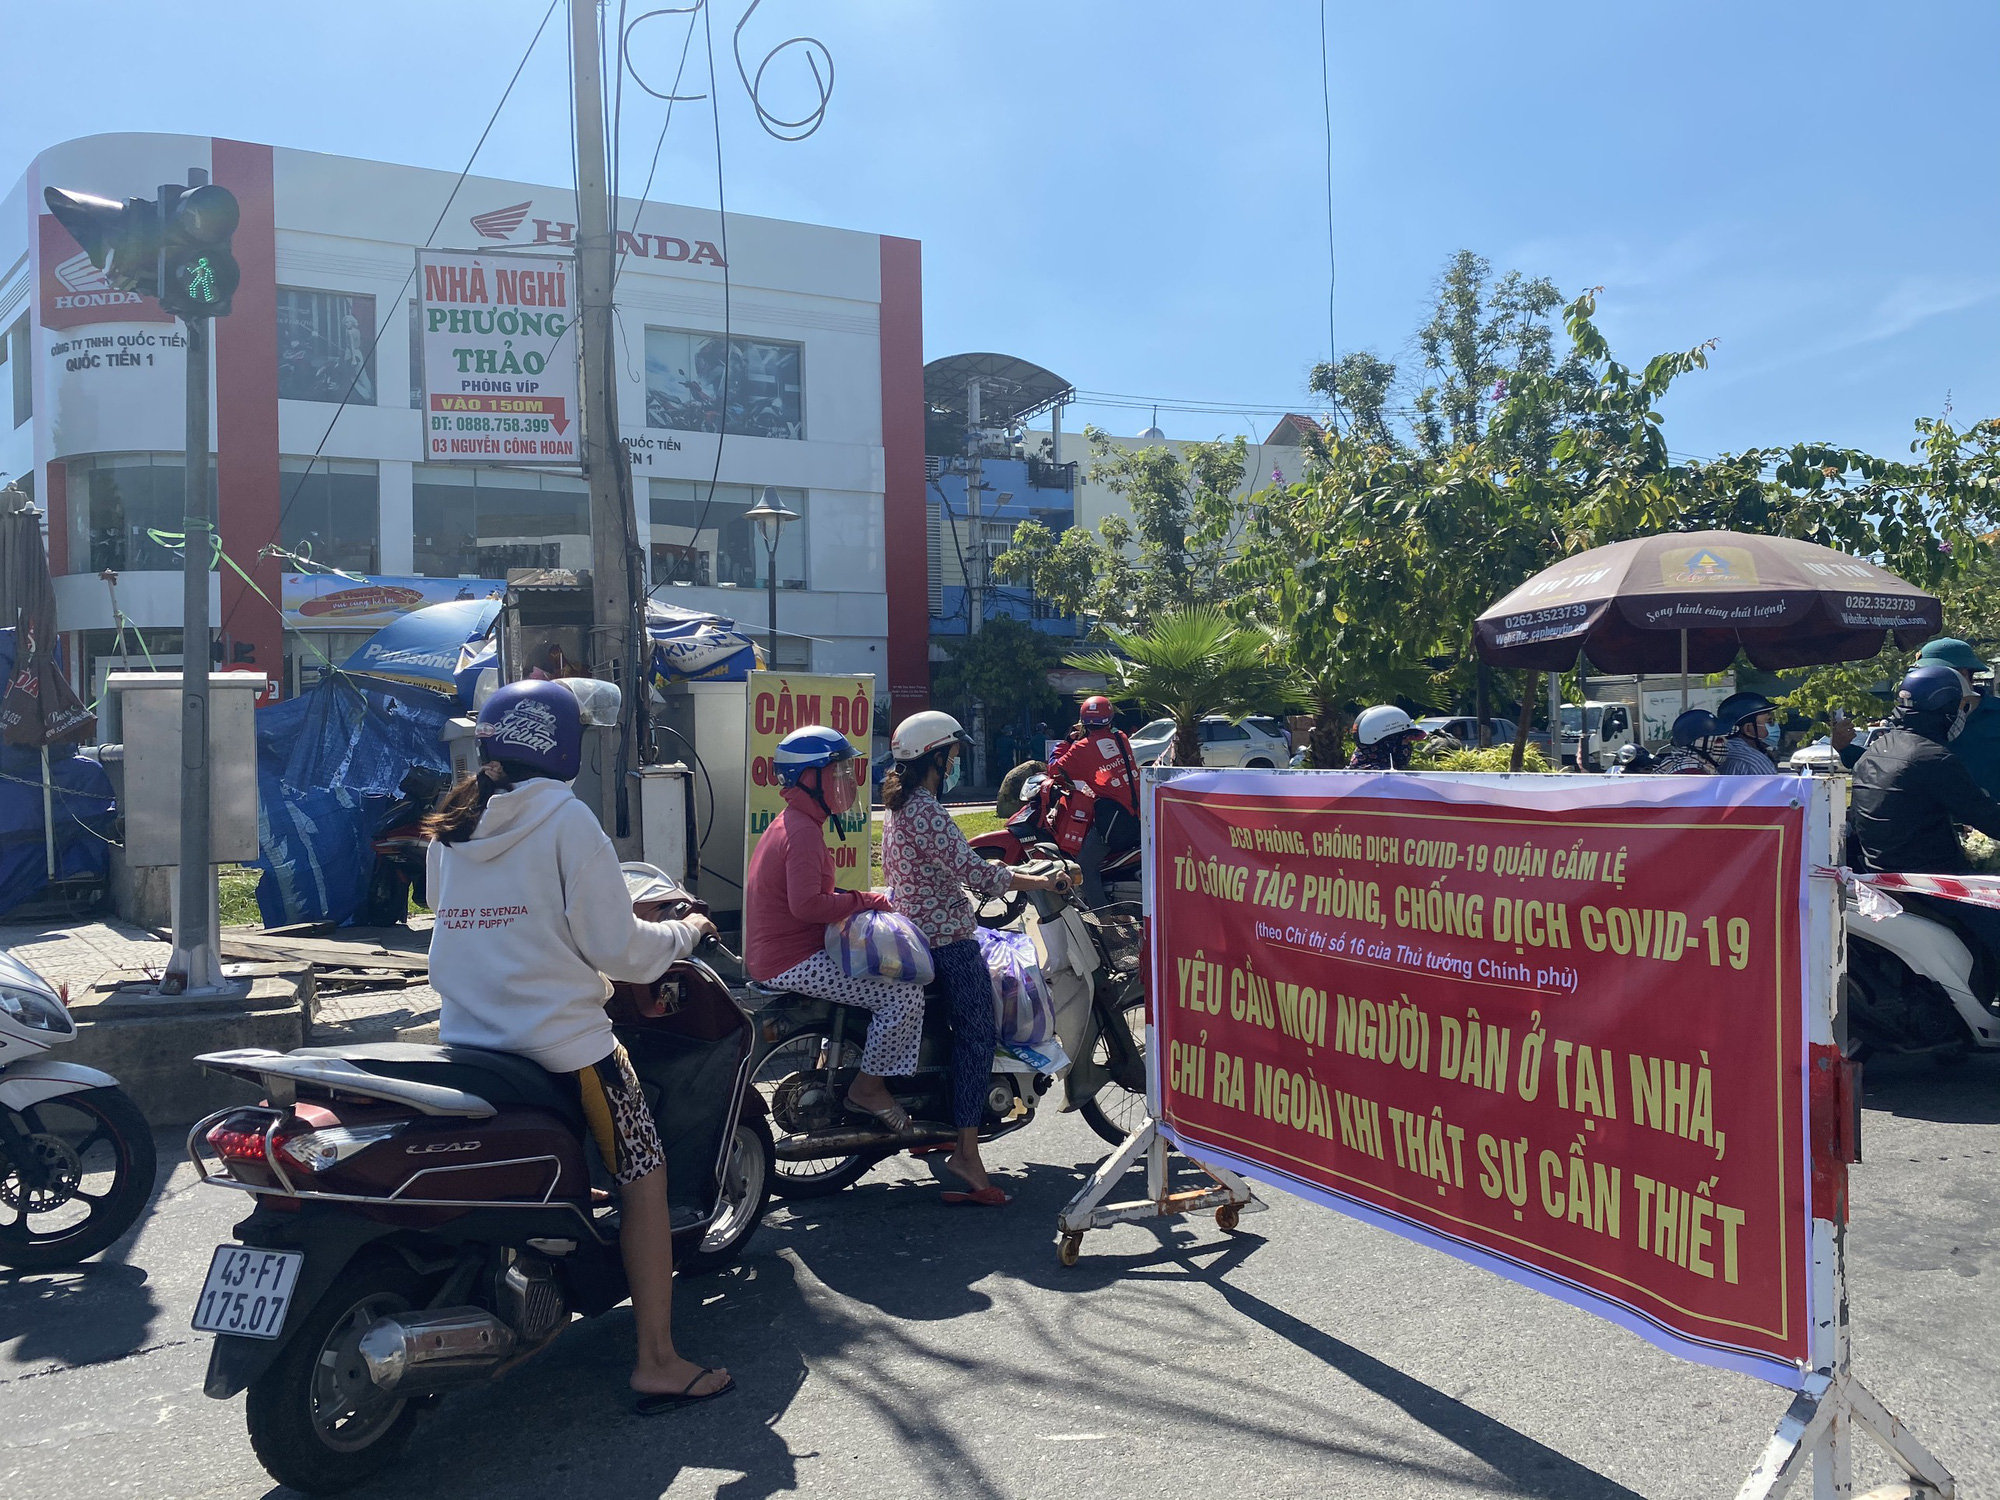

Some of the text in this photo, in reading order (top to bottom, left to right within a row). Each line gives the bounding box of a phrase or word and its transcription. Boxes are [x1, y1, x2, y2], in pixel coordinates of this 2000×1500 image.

[532, 218, 729, 268] HNDA
[425, 260, 566, 307] NHÀ NGHỈ
[54, 291, 143, 309] HONDA
[427, 306, 567, 337] PHƯƠNG
[71, 339, 83, 350] TY
[85, 336, 114, 348] TNHH
[117, 331, 155, 347] QUỐC
[159, 332, 187, 348] TIẾN
[66, 347, 154, 372] QUỐC TIẾN 1
[453, 340, 545, 375] THẢO
[462, 378, 539, 393] PHÒNG VÍP
[441, 396, 543, 412] VÀO 150M
[432, 416, 549, 433] ĐT: 0888.758.399
[432, 434, 572, 455] 03 NGUYỄN CÔNG HOAN
[621, 434, 681, 451] QUỐC TIẾN
[647, 454, 652, 465] 1
[1646, 599, 1787, 623] Song hành cùng chất lượng!
[1845, 595, 1916, 612] 0262.3523739
[1505, 604, 1587, 629] 0262.3523739
[1841, 612, 1870, 625] Website:
[1495, 630, 1529, 646] Website:
[363, 644, 457, 669] Panasonic
[754, 680, 869, 737] CẦM ĐỒ
[1228, 824, 1628, 890] BCĐ PHÒNG, CHỐNG DỊCH COVID-19 QUẬN CẨM LỆ
[480, 906, 528, 918] SEVENZIA
[1174, 845, 1750, 970] TỔ CÔNG TÁC PHÒNG, CHỐNG DỊCH COVID-19
[1255, 920, 1578, 993] (theo Chỉ thị số 16 của Thủ tướng Chính phủ)
[1177, 949, 1726, 1161] YÊU CẦU MỌI NGƯỜI DÂN Ở TẠI NHÀ,
[405, 1140, 482, 1155] LEAD
[1170, 1030, 1745, 1284] CHỈ RA NGOÀI KHI THẬT SỰ CẦN THIẾT
[220, 1252, 287, 1291] 43-F1
[202, 1290, 285, 1333] 175.07
